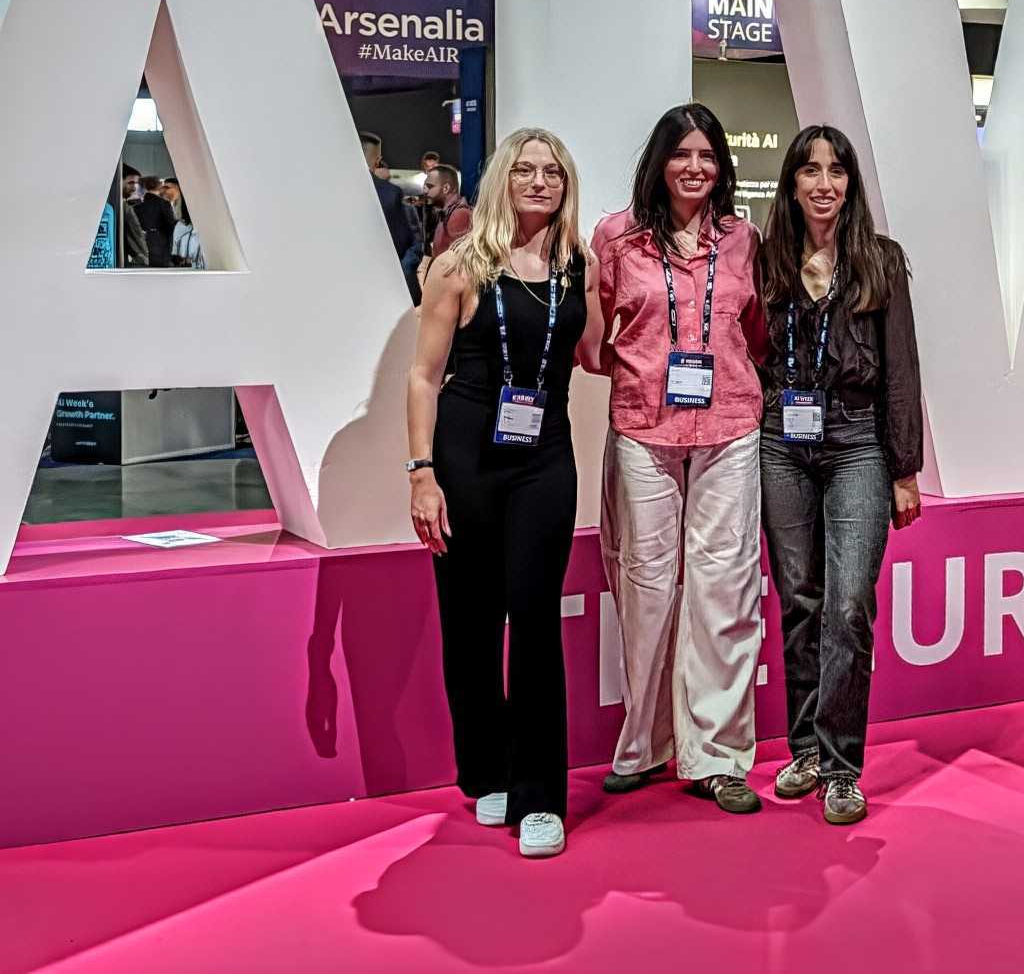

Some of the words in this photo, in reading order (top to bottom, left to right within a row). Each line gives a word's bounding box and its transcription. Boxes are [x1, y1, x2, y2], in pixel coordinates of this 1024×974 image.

[320, 3, 485, 42] Arsenalia
[707, 19, 773, 42] STAGE
[358, 44, 460, 63] #MakeAIR
[762, 133, 778, 148] AI
[674, 396, 706, 404] BUSINESS
[503, 434, 533, 443] BUSINESS
